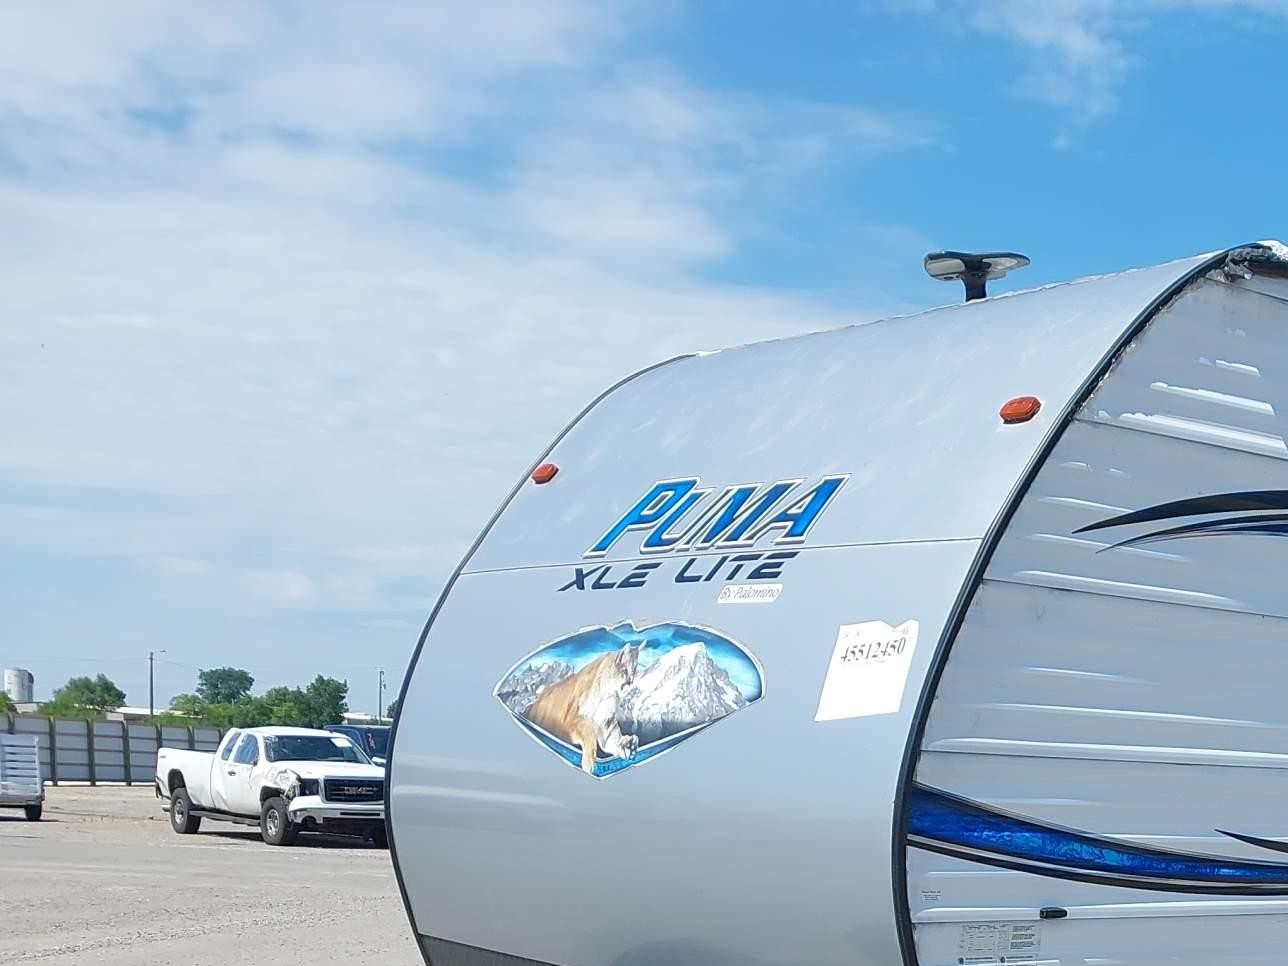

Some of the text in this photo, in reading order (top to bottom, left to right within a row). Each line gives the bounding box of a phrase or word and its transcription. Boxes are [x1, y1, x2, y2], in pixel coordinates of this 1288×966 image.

[582, 473, 852, 559] PUMA
[556, 551, 800, 592] XLE LITE
[840, 636, 907, 662] 45512450
